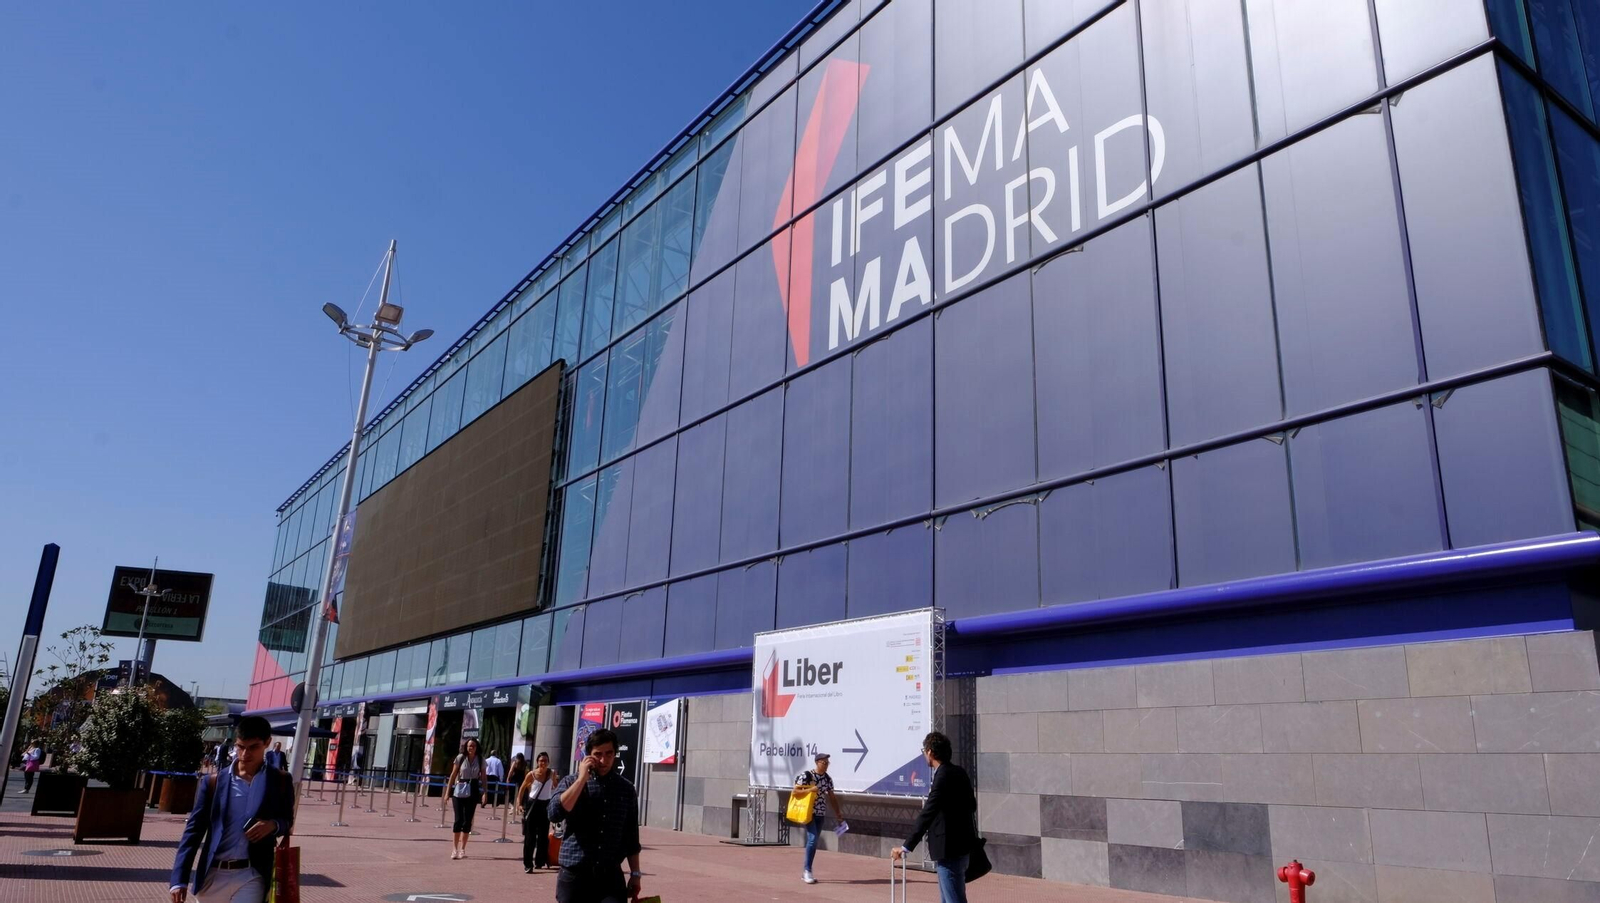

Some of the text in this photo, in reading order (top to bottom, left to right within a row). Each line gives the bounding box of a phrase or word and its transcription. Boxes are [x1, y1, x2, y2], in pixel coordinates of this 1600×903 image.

[831, 68, 1070, 267] IFEMA
[828, 114, 1166, 351] MADRID
[783, 657, 843, 688] Liber
[759, 743, 818, 757] Pabellón 14
